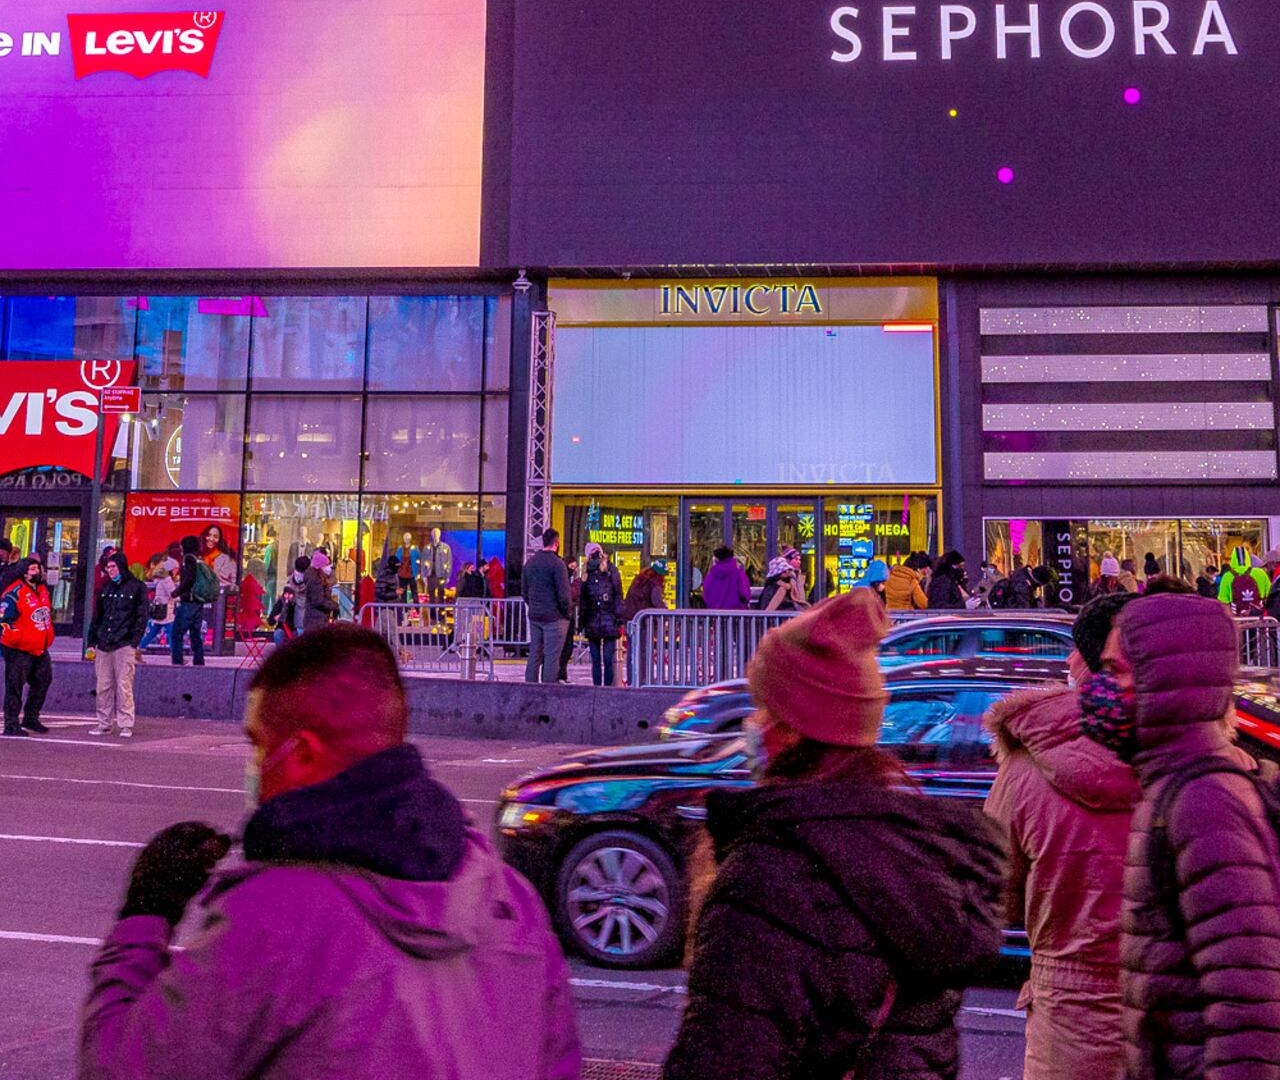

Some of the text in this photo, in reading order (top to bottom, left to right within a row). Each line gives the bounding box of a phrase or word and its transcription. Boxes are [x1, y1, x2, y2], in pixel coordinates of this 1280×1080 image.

[21, 32, 61, 56] IN
[831, 1, 1237, 62] SEPHORA
[661, 283, 822, 313] INVICTA
[131, 506, 231, 517] GIVE BETTER
[874, 524, 910, 536] MEGA
[1056, 532, 1074, 603] SEPHO
